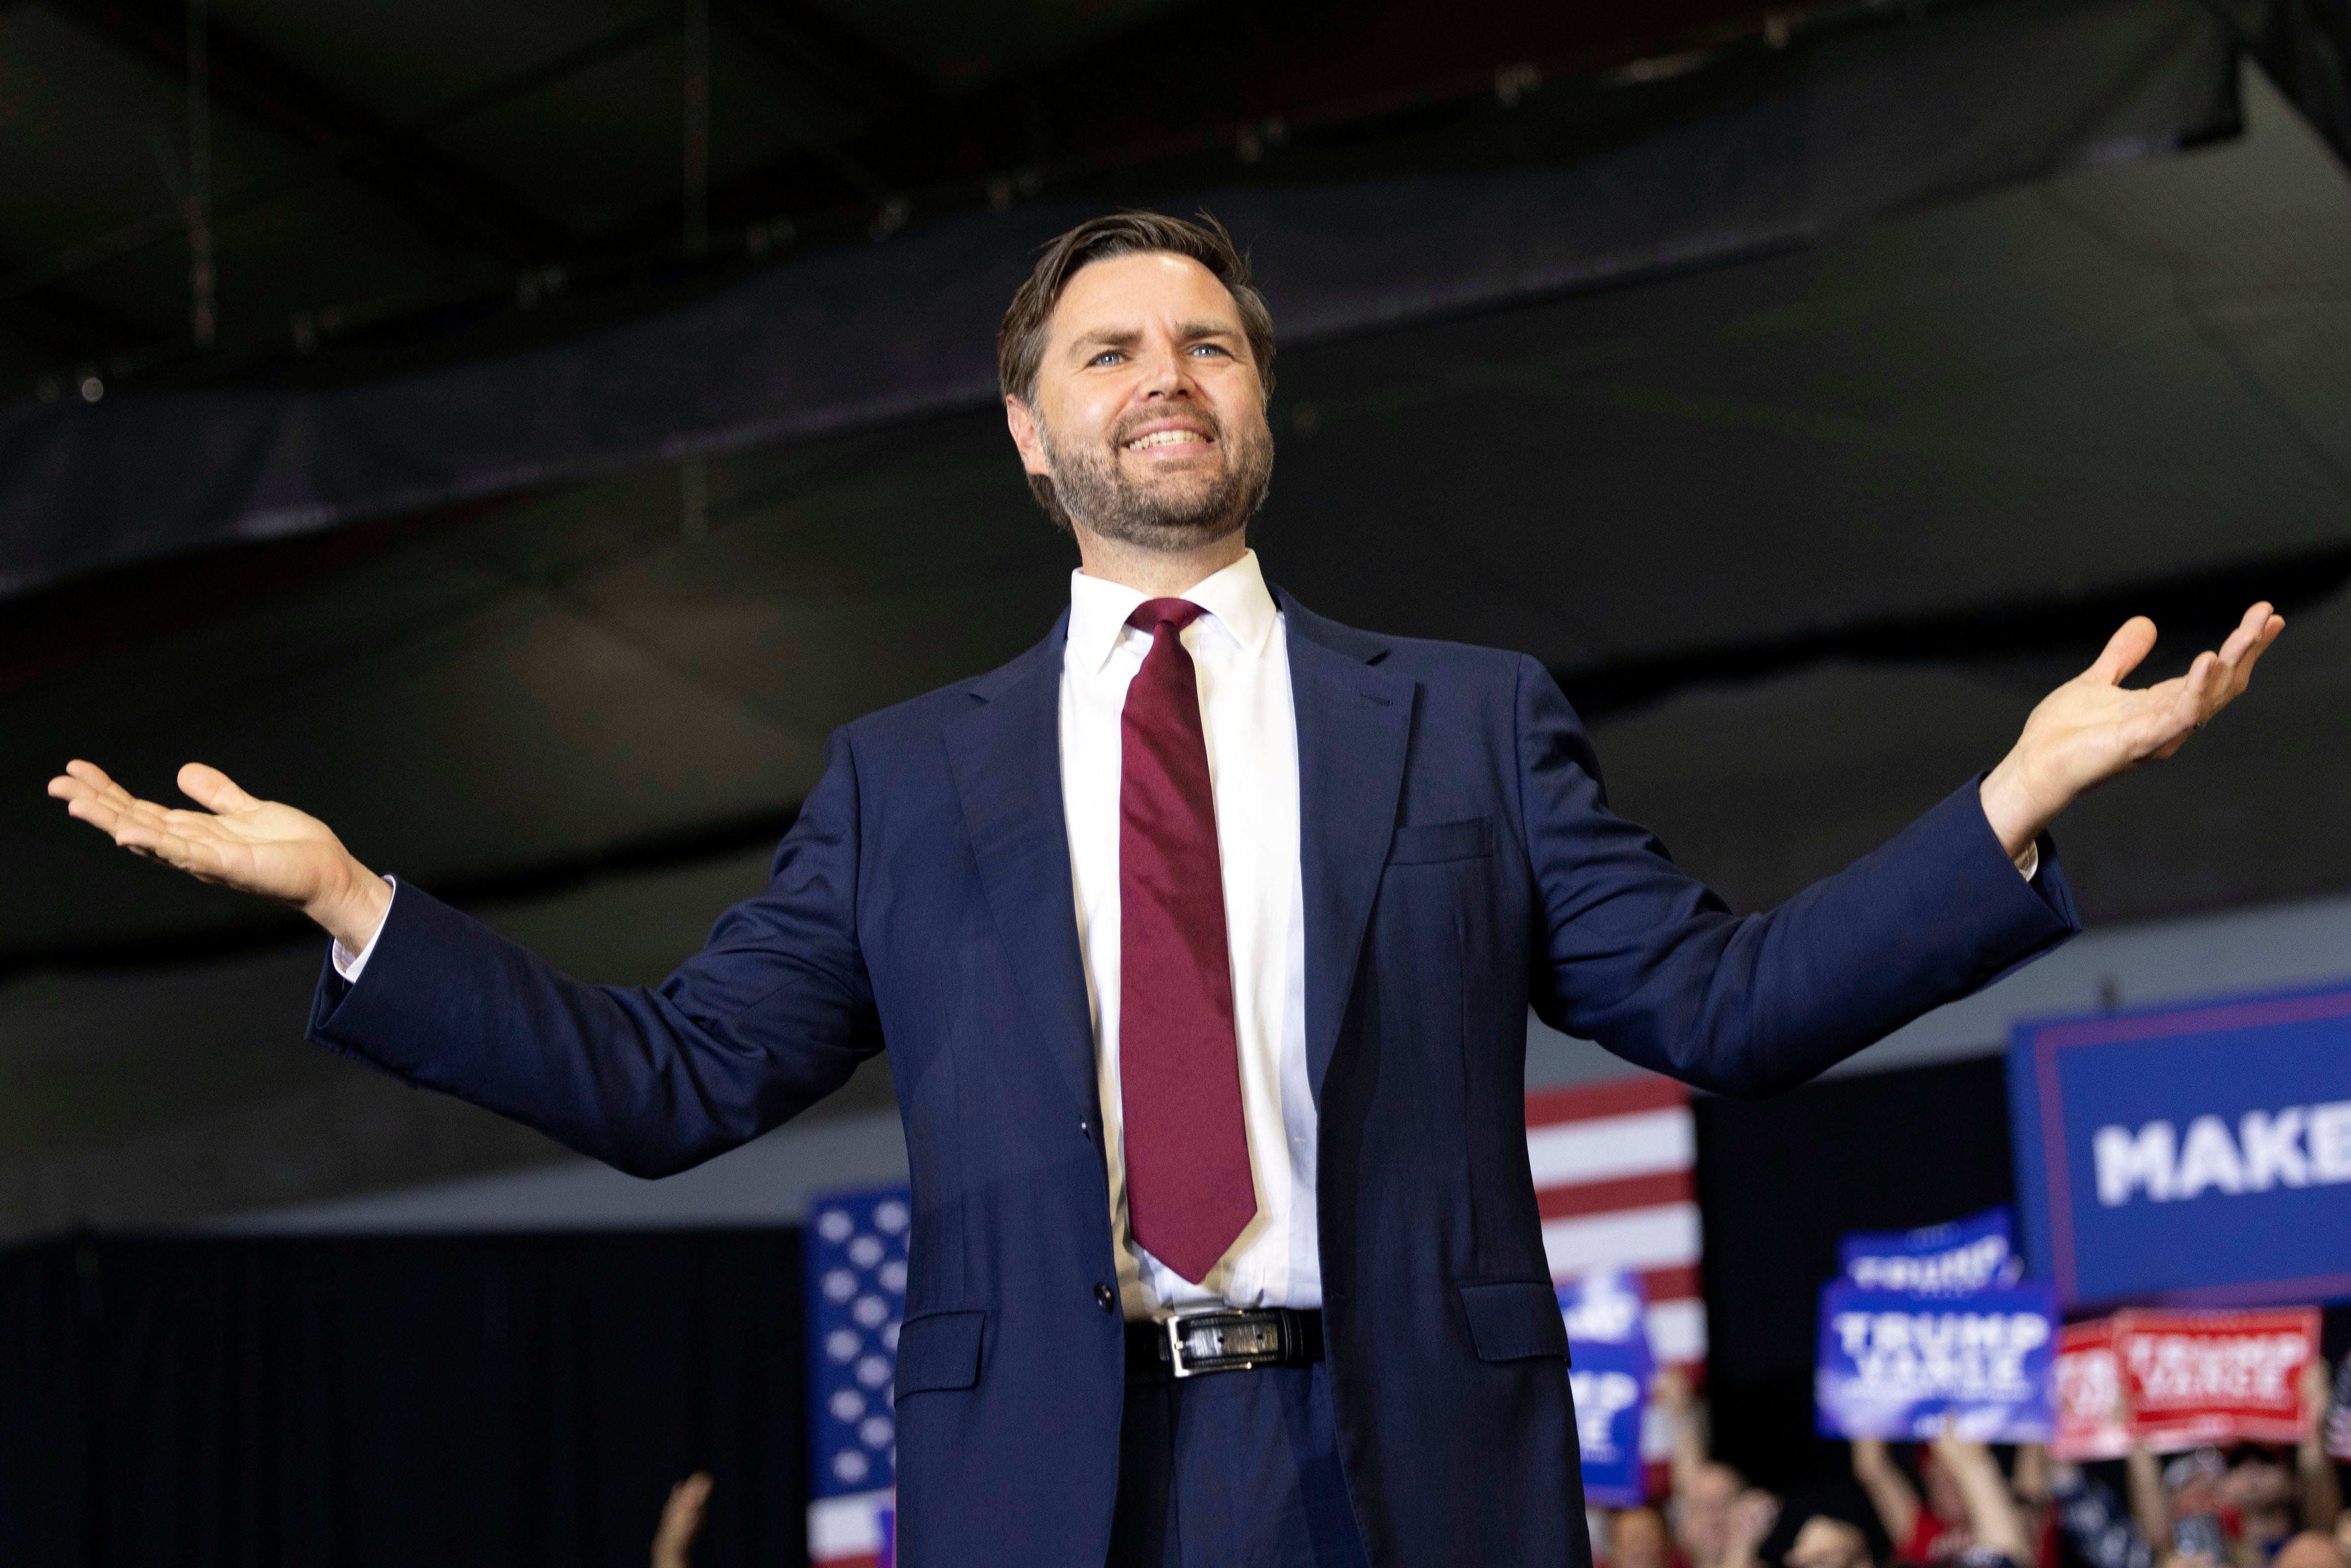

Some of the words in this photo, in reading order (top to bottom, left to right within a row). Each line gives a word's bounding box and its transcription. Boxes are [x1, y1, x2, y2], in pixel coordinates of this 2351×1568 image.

[2093, 1100, 2351, 1208] MAKE
[1848, 1234, 2009, 1293] TRUMP
[1834, 1311, 2051, 1359] TRUMP
[2122, 1333, 2311, 1371] TRUMP
[2140, 1361, 2289, 1400] VANCE
